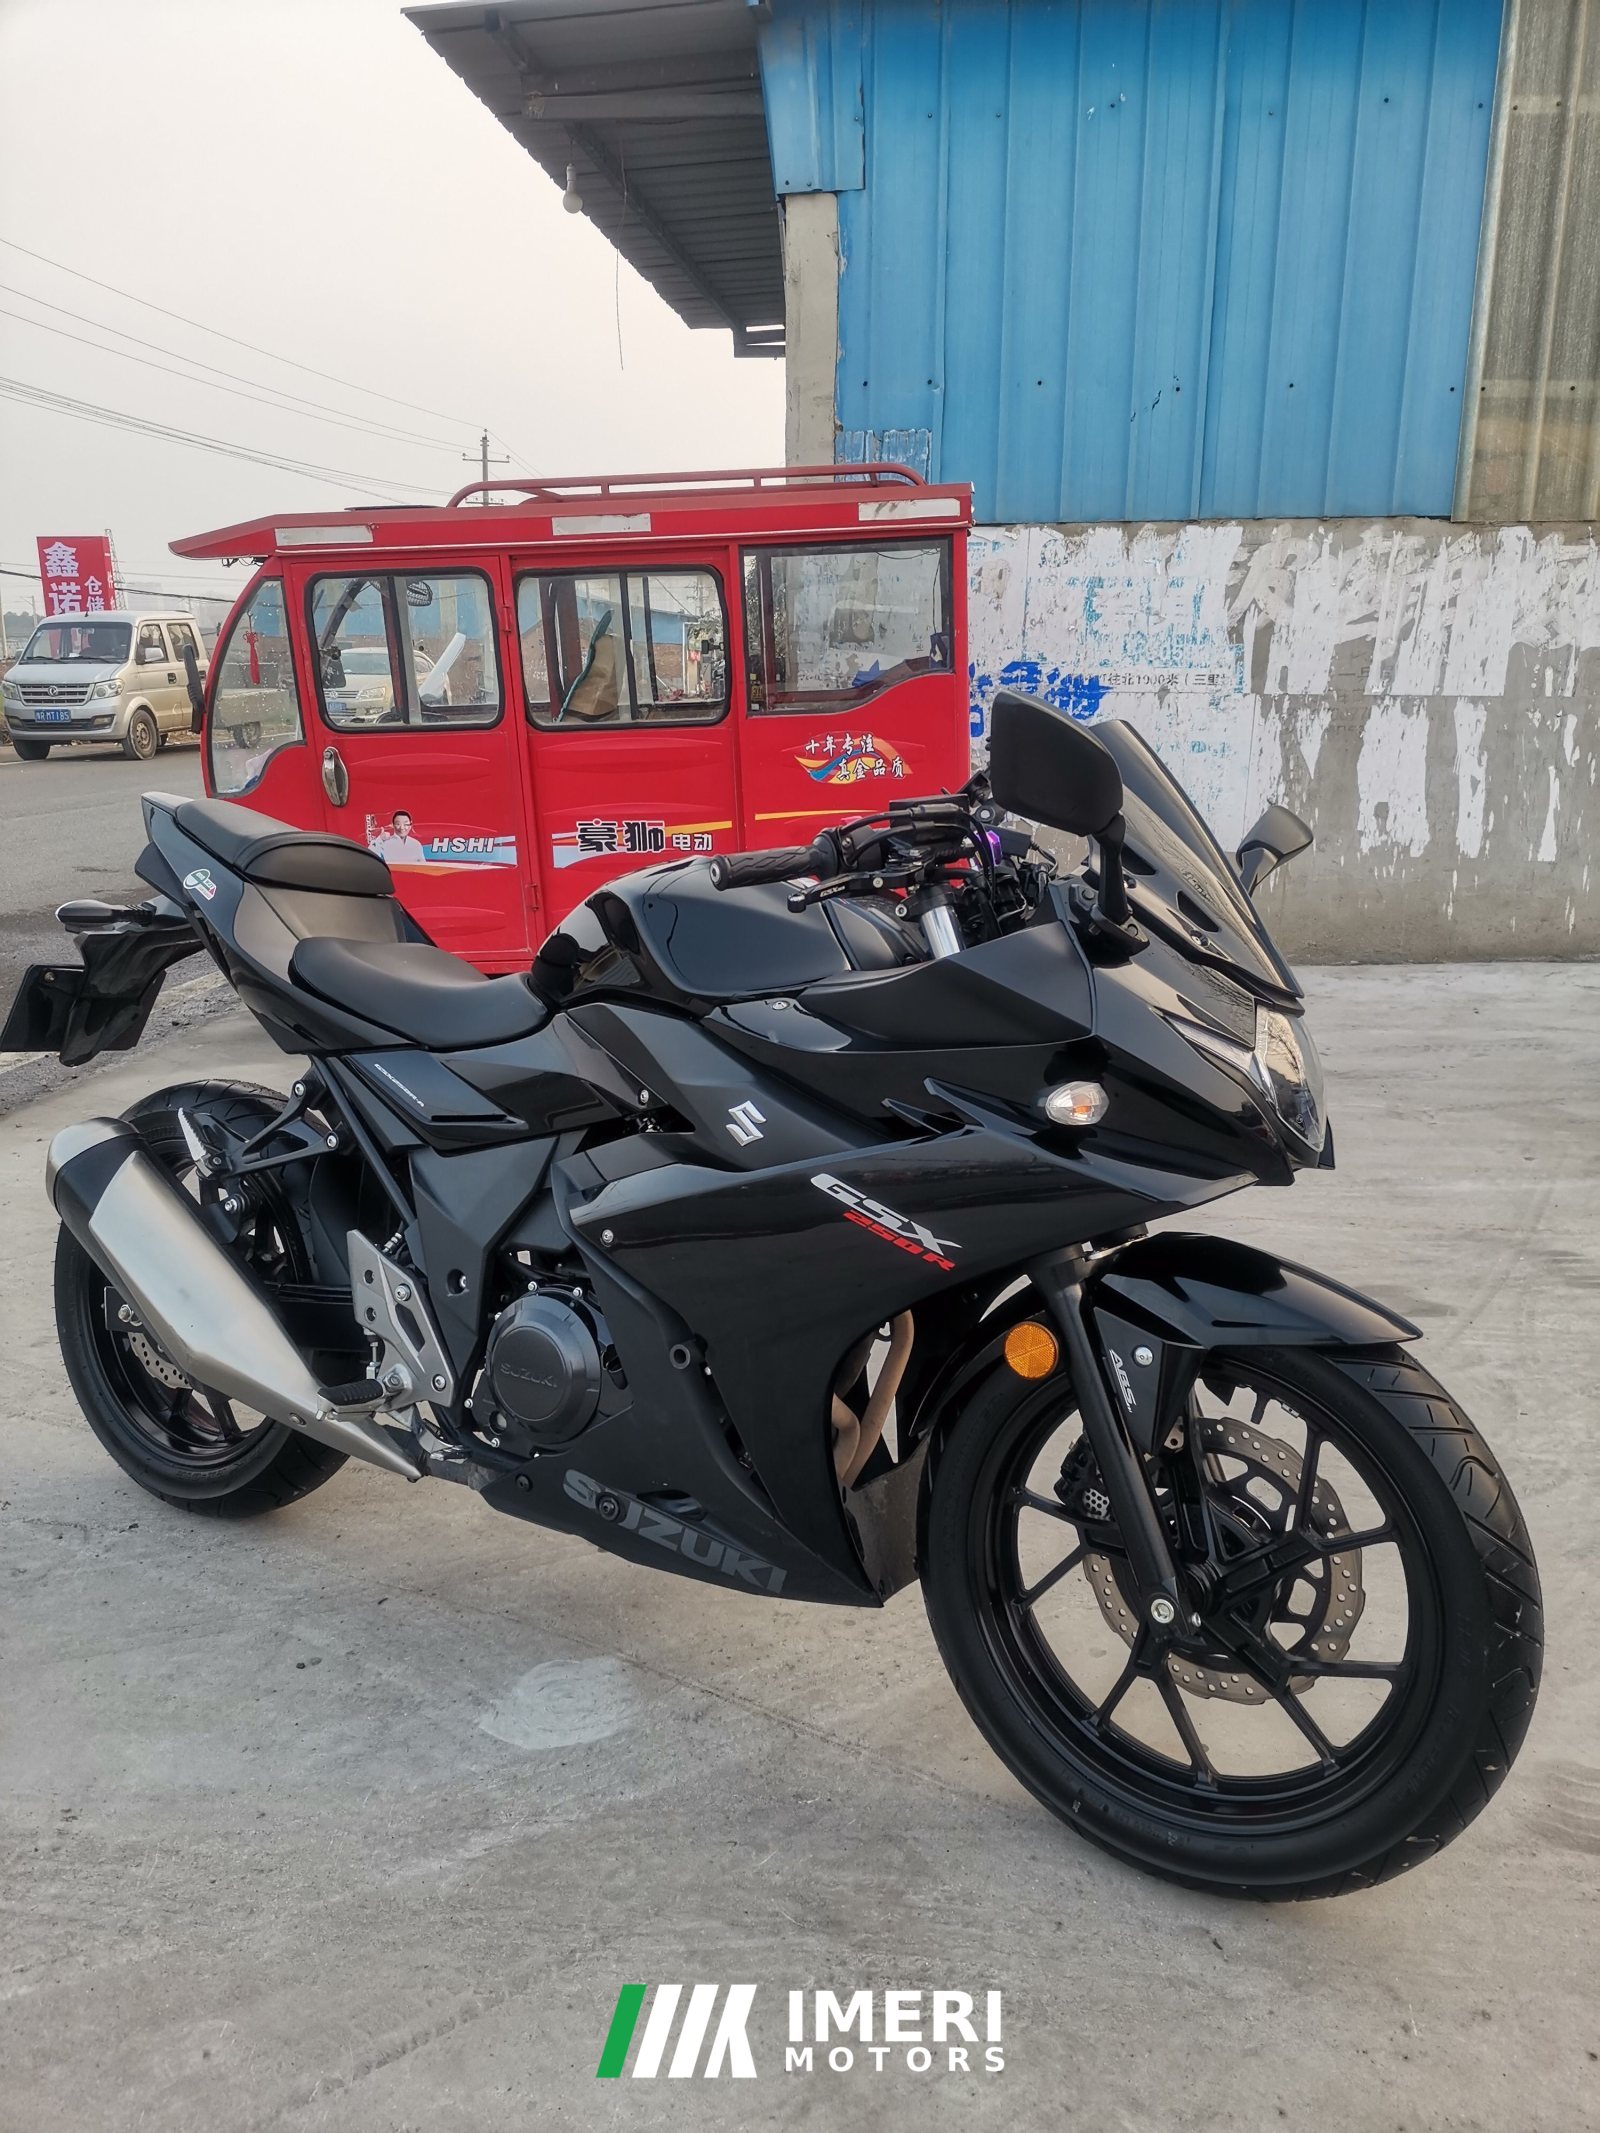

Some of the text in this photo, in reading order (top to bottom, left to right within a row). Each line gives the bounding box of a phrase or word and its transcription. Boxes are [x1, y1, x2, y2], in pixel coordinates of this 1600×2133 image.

[43, 541, 82, 615] 鑫诺
[84, 575, 104, 612] 仓储
[805, 733, 875, 757] 十年专注
[836, 757, 904, 781] 真金品质
[431, 837, 496, 854] HSHI
[672, 833, 713, 852] 电动
[1109, 1349, 1137, 1408] ABS
